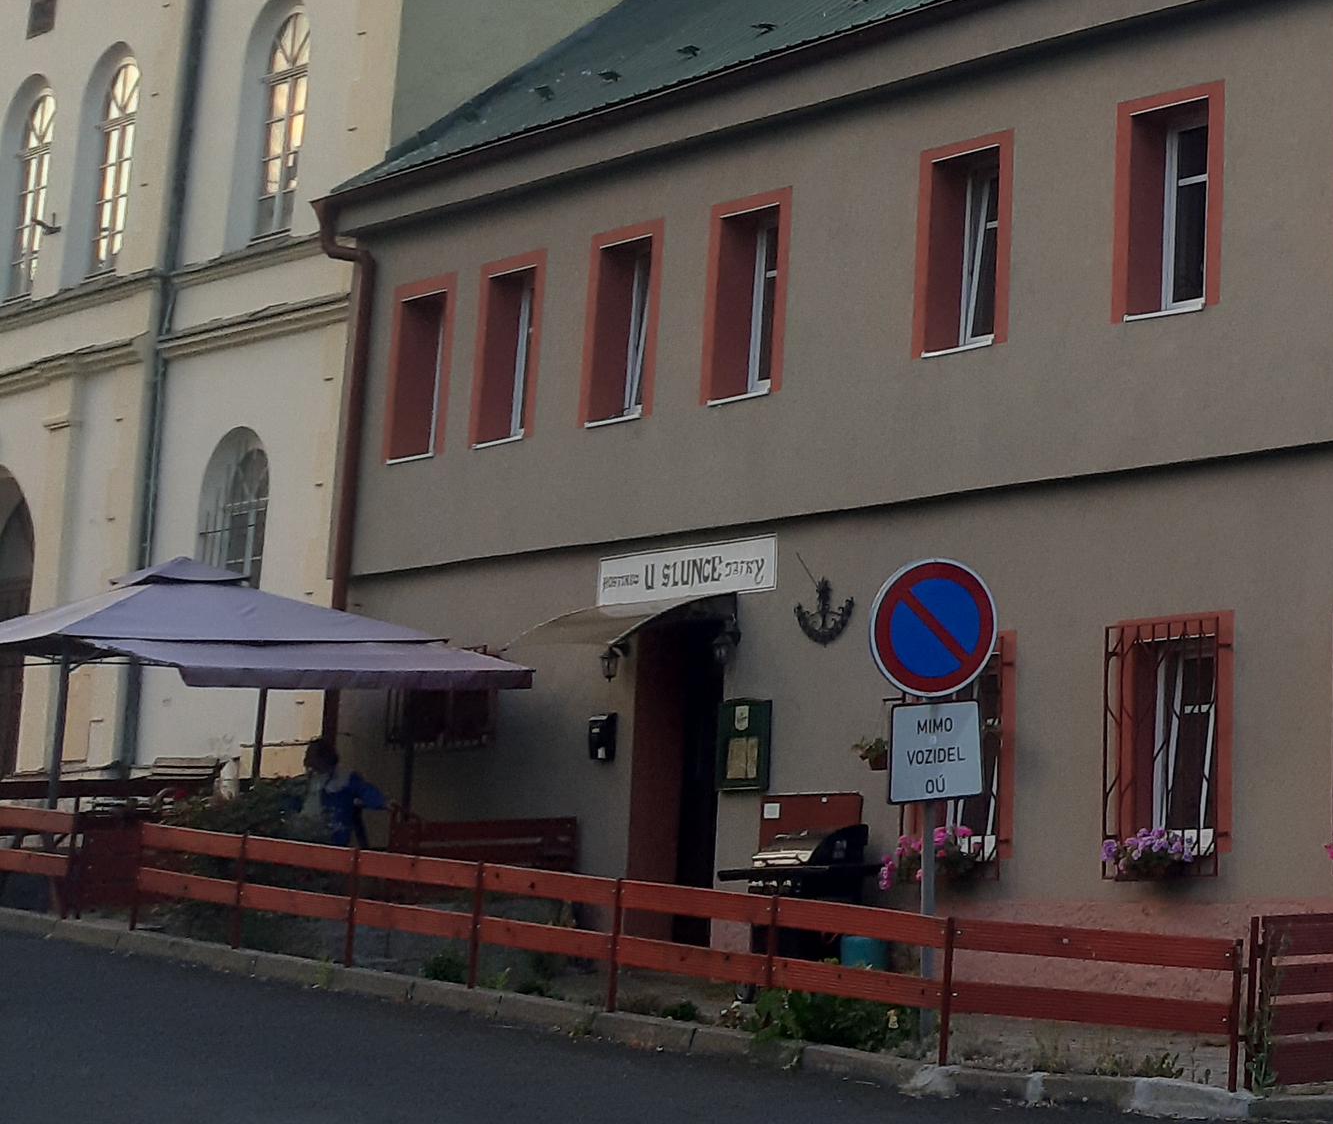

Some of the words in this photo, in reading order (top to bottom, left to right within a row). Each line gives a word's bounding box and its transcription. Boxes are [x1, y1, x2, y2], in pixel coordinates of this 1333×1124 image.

[644, 563, 655, 590] U
[661, 556, 723, 587] SLUNCE
[917, 717, 953, 735] MIMO
[906, 747, 966, 766] VOZIDEL
[925, 774, 946, 794] OÚ
